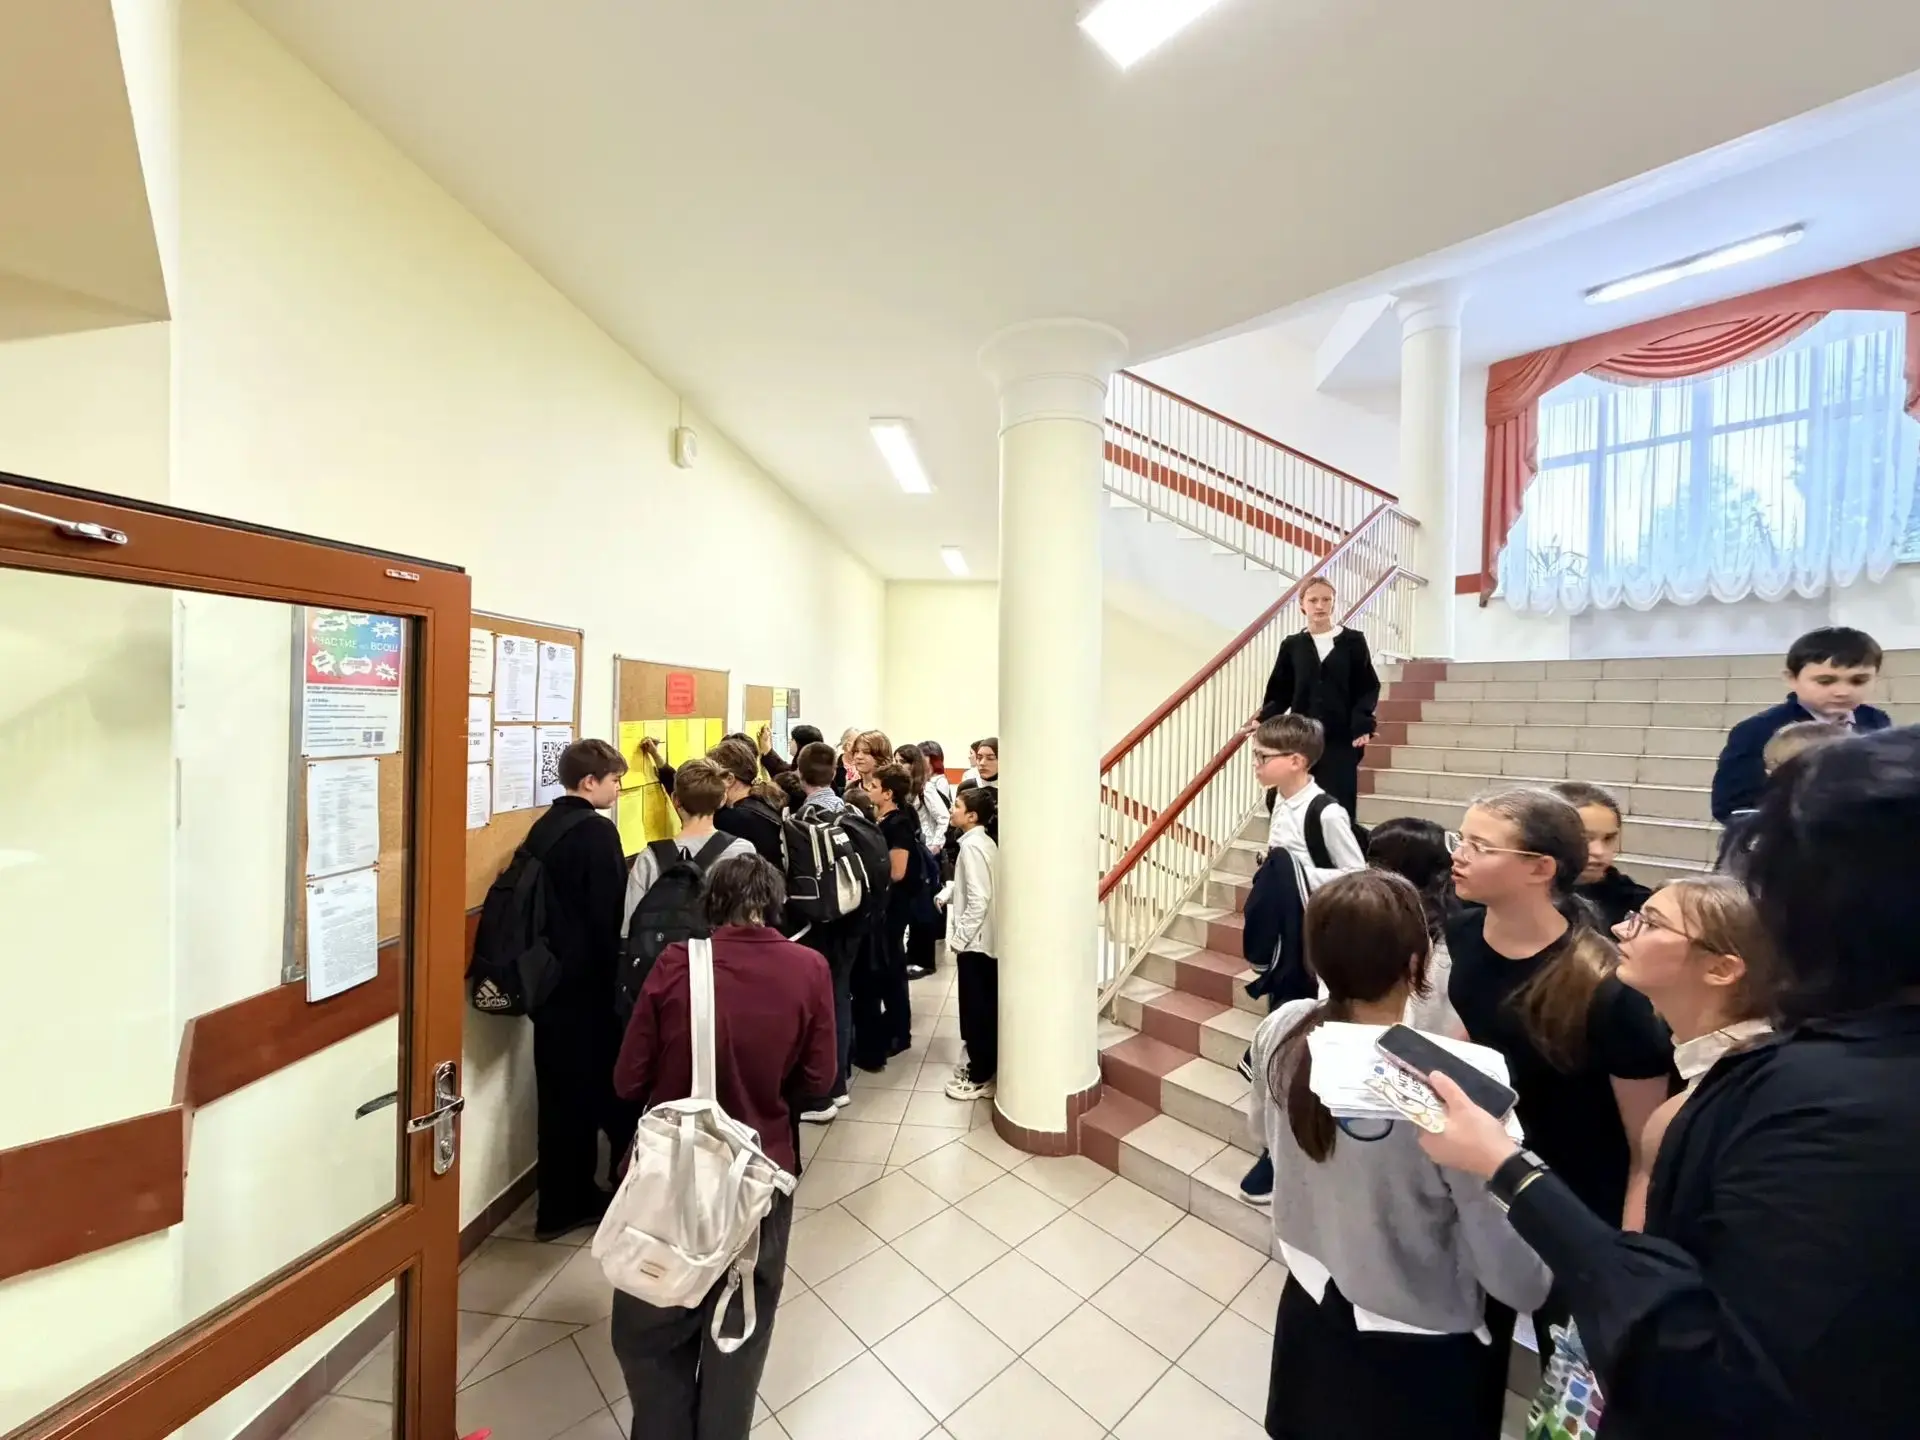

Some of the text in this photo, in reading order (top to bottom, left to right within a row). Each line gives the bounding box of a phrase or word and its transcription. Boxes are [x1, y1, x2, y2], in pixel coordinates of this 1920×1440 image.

[311, 636, 358, 649] УЧАСТИЕ
[371, 642, 399, 652] ВСОШ
[475, 996, 509, 1008] adidas
